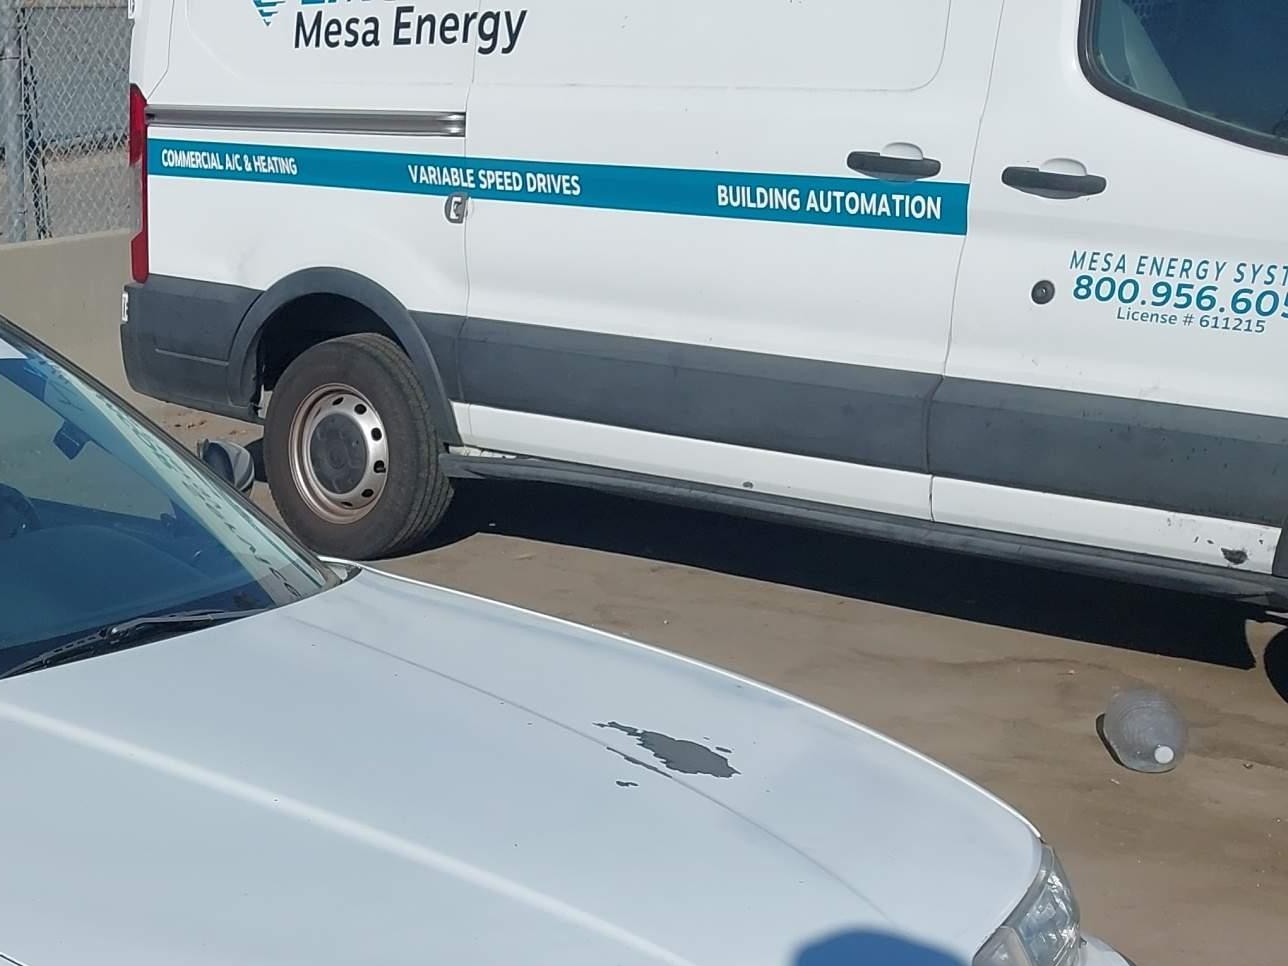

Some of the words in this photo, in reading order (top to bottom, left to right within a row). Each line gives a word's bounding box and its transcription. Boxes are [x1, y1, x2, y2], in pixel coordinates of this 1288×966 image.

[294, 10, 380, 48] Mesa
[392, 6, 528, 54] Energy
[161, 149, 224, 170] COMMERCIAL
[225, 153, 243, 171] A/C
[244, 157, 253, 172] &
[253, 155, 298, 175] HEATING
[408, 164, 476, 188] VARIABLE
[478, 169, 523, 192] SPEED
[526, 173, 581, 196] DRIVES
[717, 184, 800, 211] BUILDING
[806, 190, 942, 220] AUTOMATION
[1069, 250, 1127, 274] MESA
[1135, 255, 1227, 282] ENERGY
[1116, 306, 1179, 325] License
[1182, 313, 1195, 326] #
[1199, 314, 1266, 334] 611215
